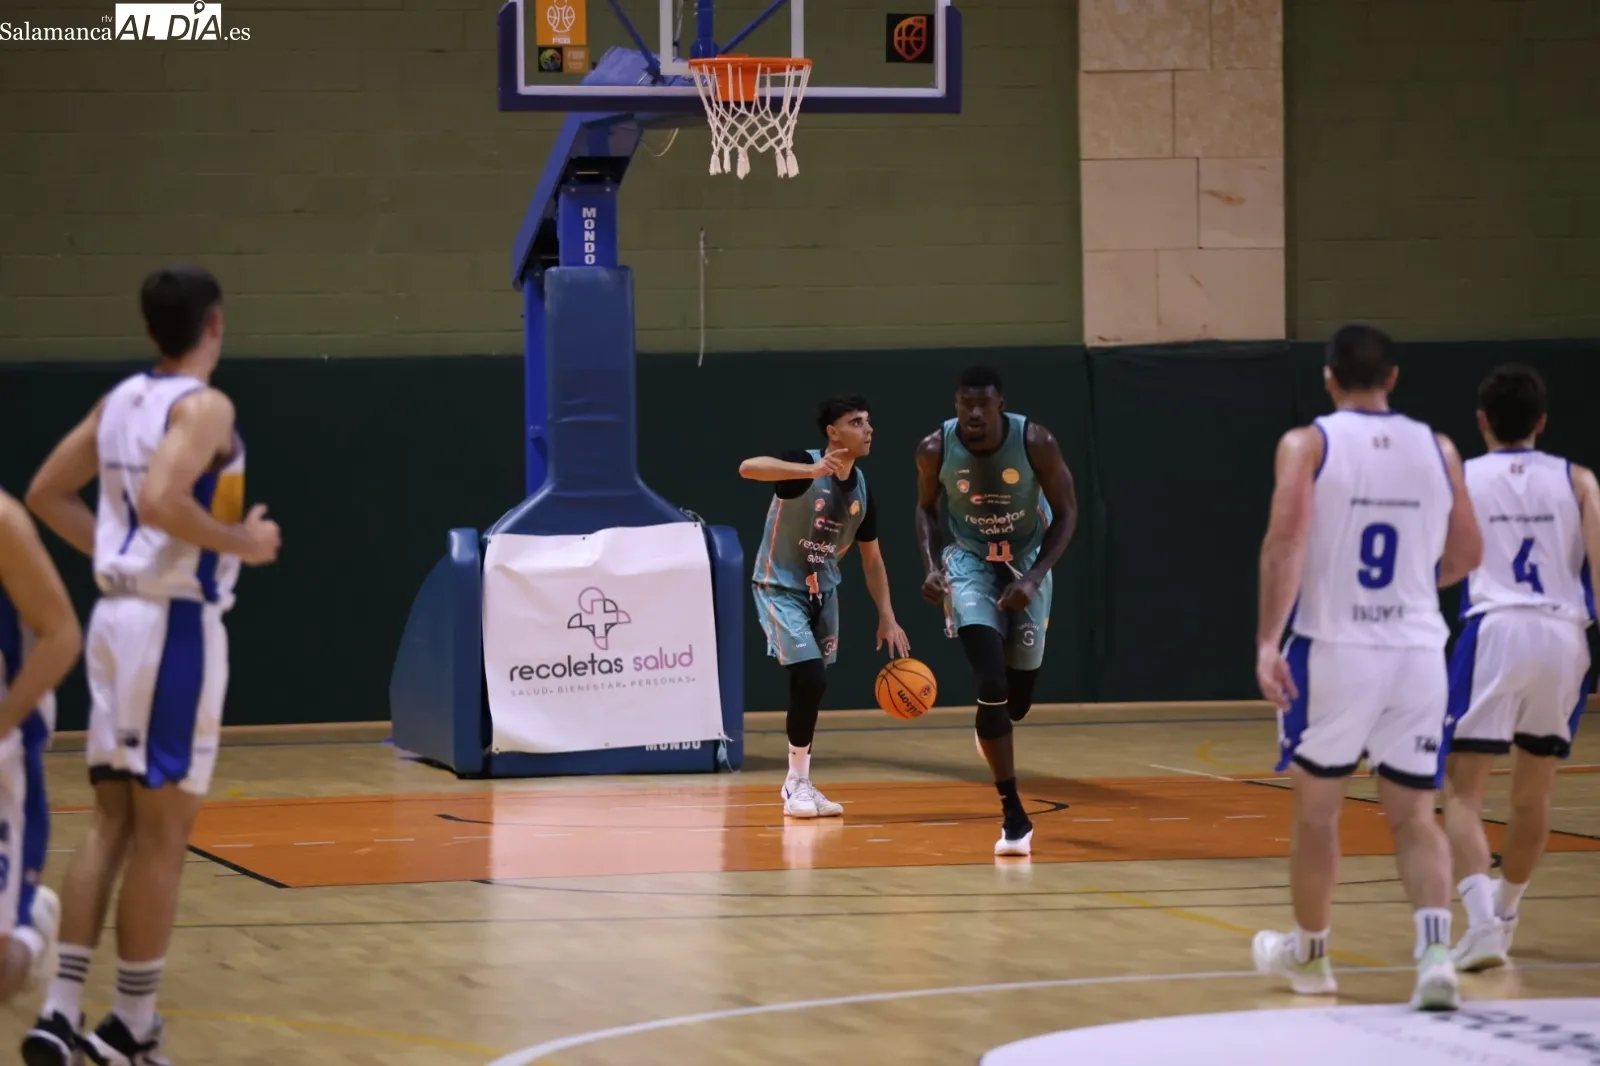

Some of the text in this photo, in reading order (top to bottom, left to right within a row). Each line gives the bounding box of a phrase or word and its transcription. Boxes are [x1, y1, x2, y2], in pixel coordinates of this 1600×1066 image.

[582, 207, 597, 265] MONDO
[1357, 522, 1399, 590] 9
[1512, 537, 1545, 594] 4
[509, 644, 694, 682] recoletas salud
